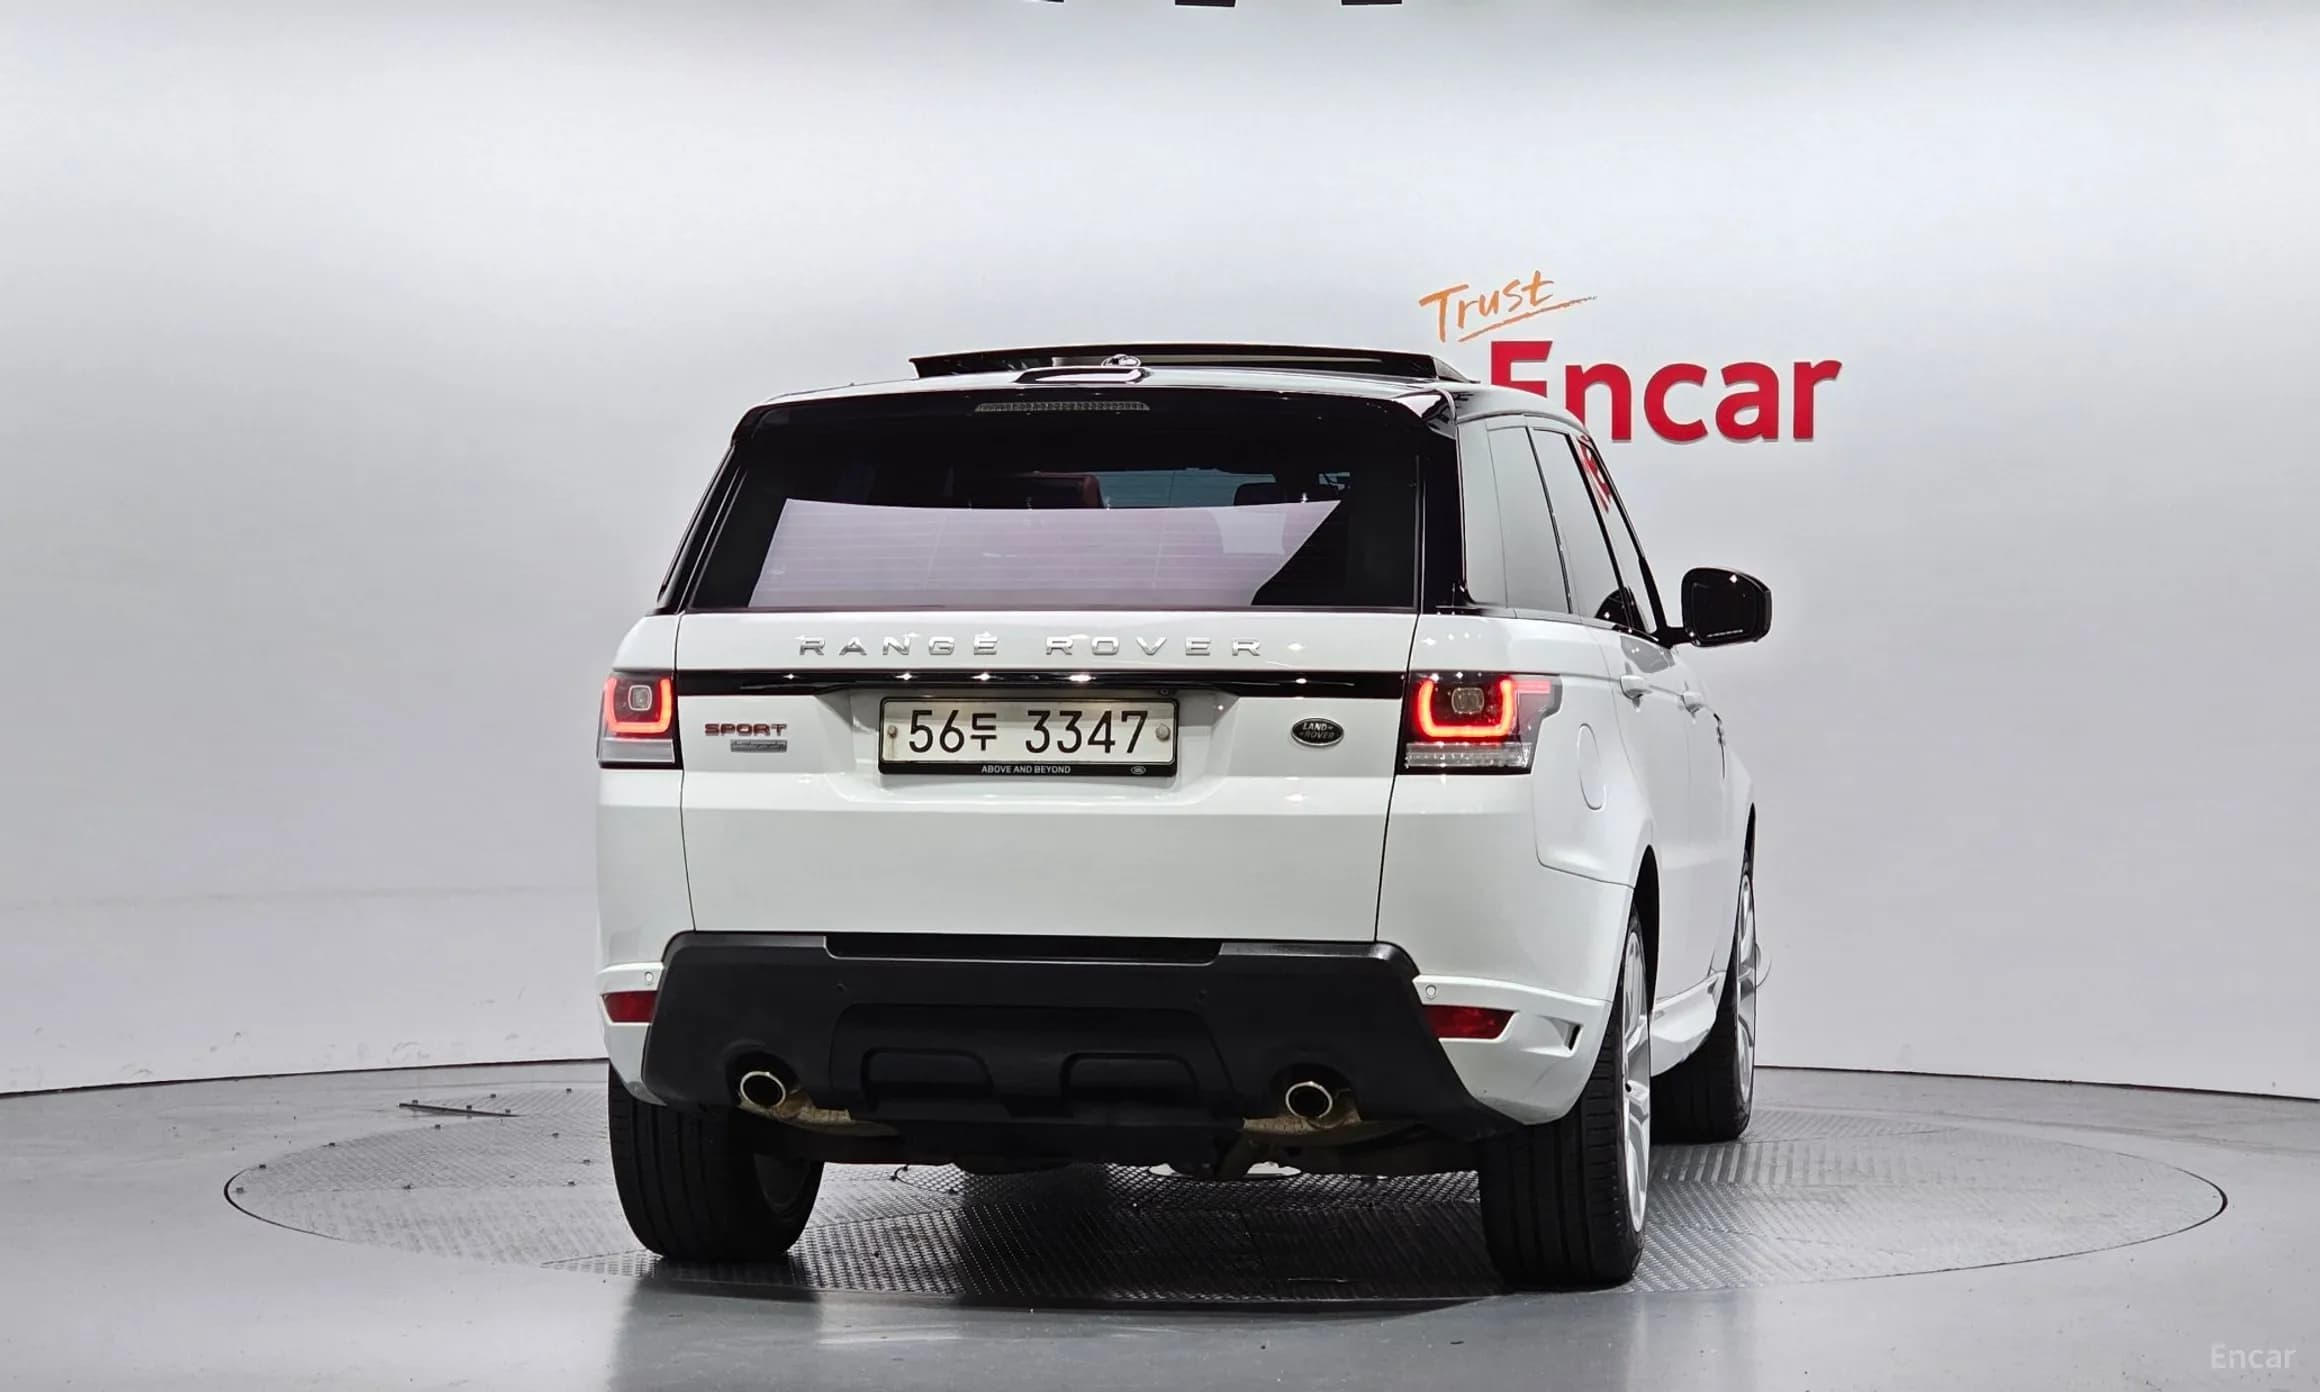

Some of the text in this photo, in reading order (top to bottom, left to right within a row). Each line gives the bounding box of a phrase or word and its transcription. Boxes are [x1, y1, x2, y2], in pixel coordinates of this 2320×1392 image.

[1418, 269, 1556, 343] Trust
[798, 634, 1261, 656] RANGE ROVER
[704, 723, 788, 736] SPORT
[908, 709, 1149, 754] 56두 3347
[981, 765, 1071, 774] ABOVE AND BEYOND
